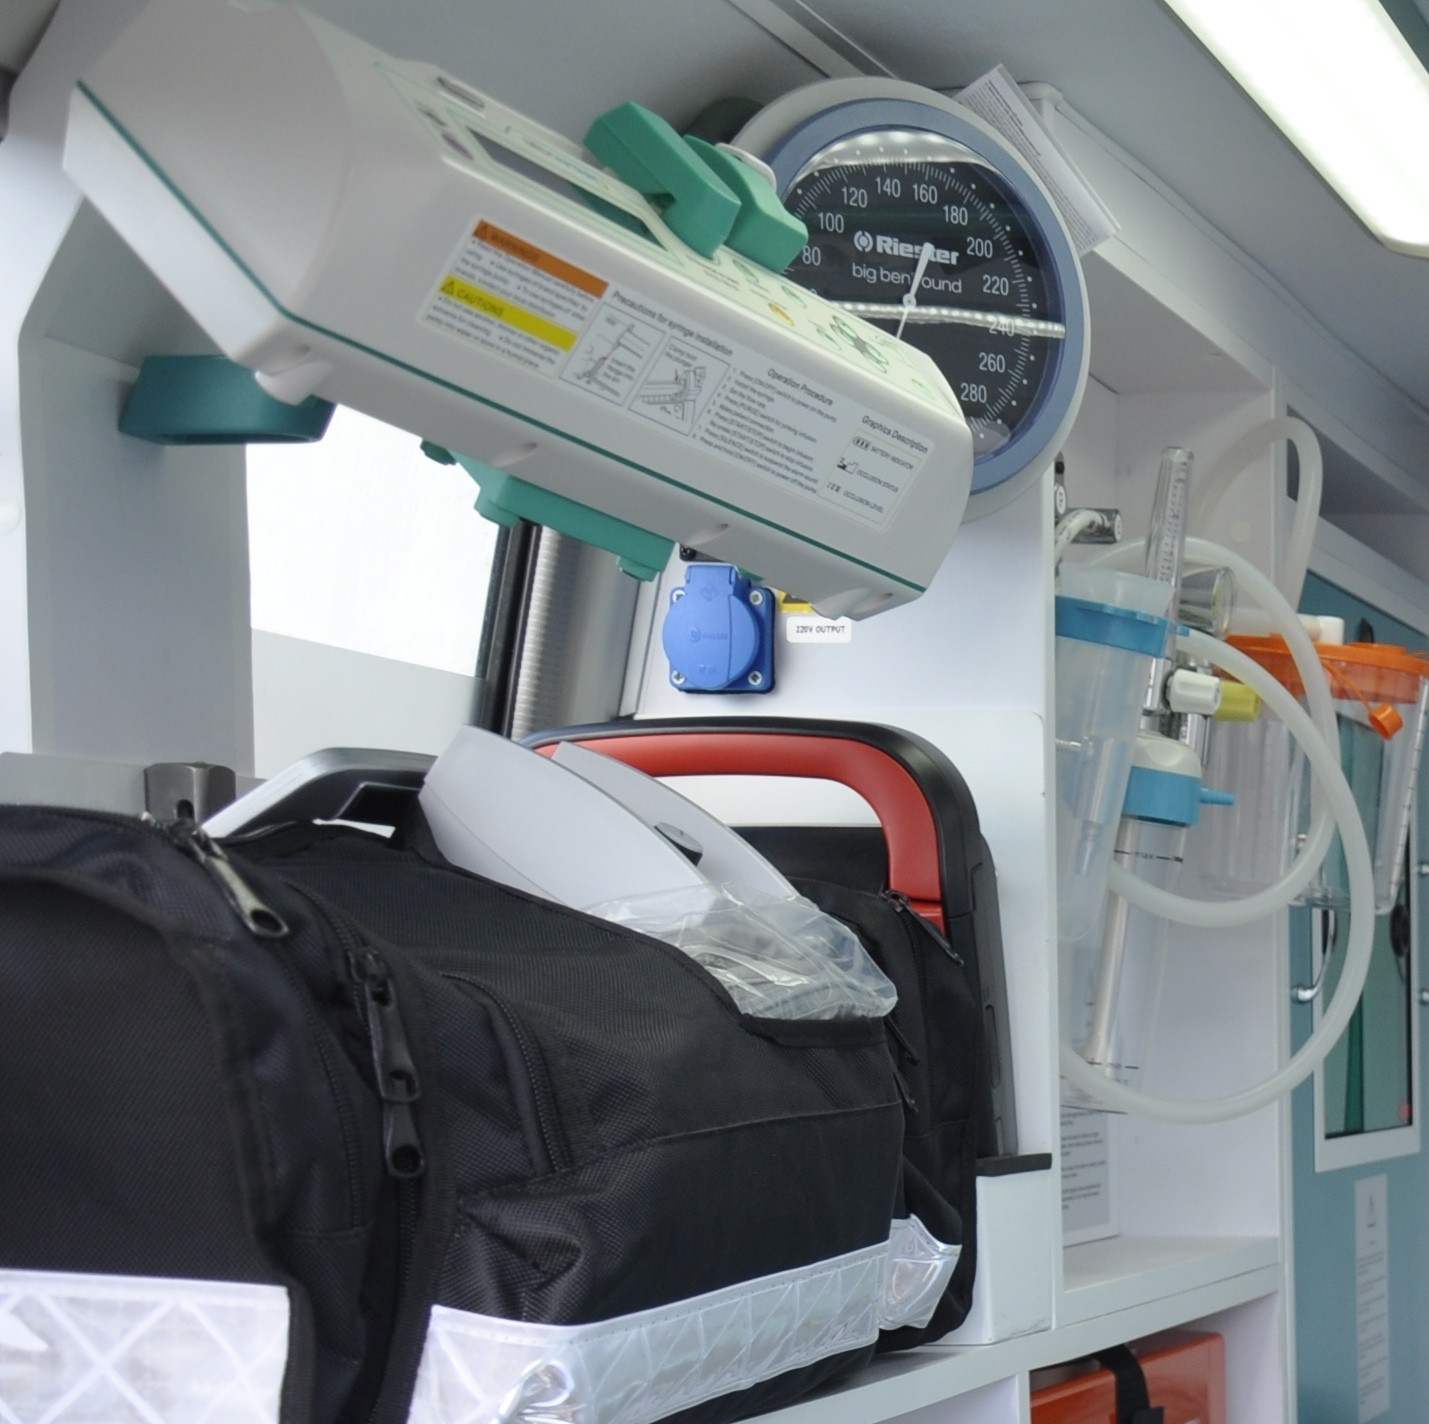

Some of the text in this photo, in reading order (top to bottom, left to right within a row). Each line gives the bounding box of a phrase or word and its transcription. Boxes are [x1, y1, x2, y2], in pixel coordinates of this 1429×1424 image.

[841, 187, 868, 208] 120
[876, 177, 900, 197] 140
[913, 183, 938, 204] 160
[818, 212, 844, 233] 100
[943, 205, 968, 225] 180
[802, 245, 821, 266] 80
[966, 236, 993, 258] 200
[852, 263, 962, 293] big ben ound
[982, 275, 1009, 296] 220
[455, 287, 505, 318] CAUTIONS
[611, 289, 658, 319] Precautions
[655, 312, 669, 324] for
[694, 331, 734, 357] installation
[979, 352, 1005, 373] 260
[766, 367, 834, 407] Operation Procedure
[961, 382, 987, 403] 280
[860, 413, 929, 455] Graphics Description
[816, 625, 846, 633] OUTPUT
